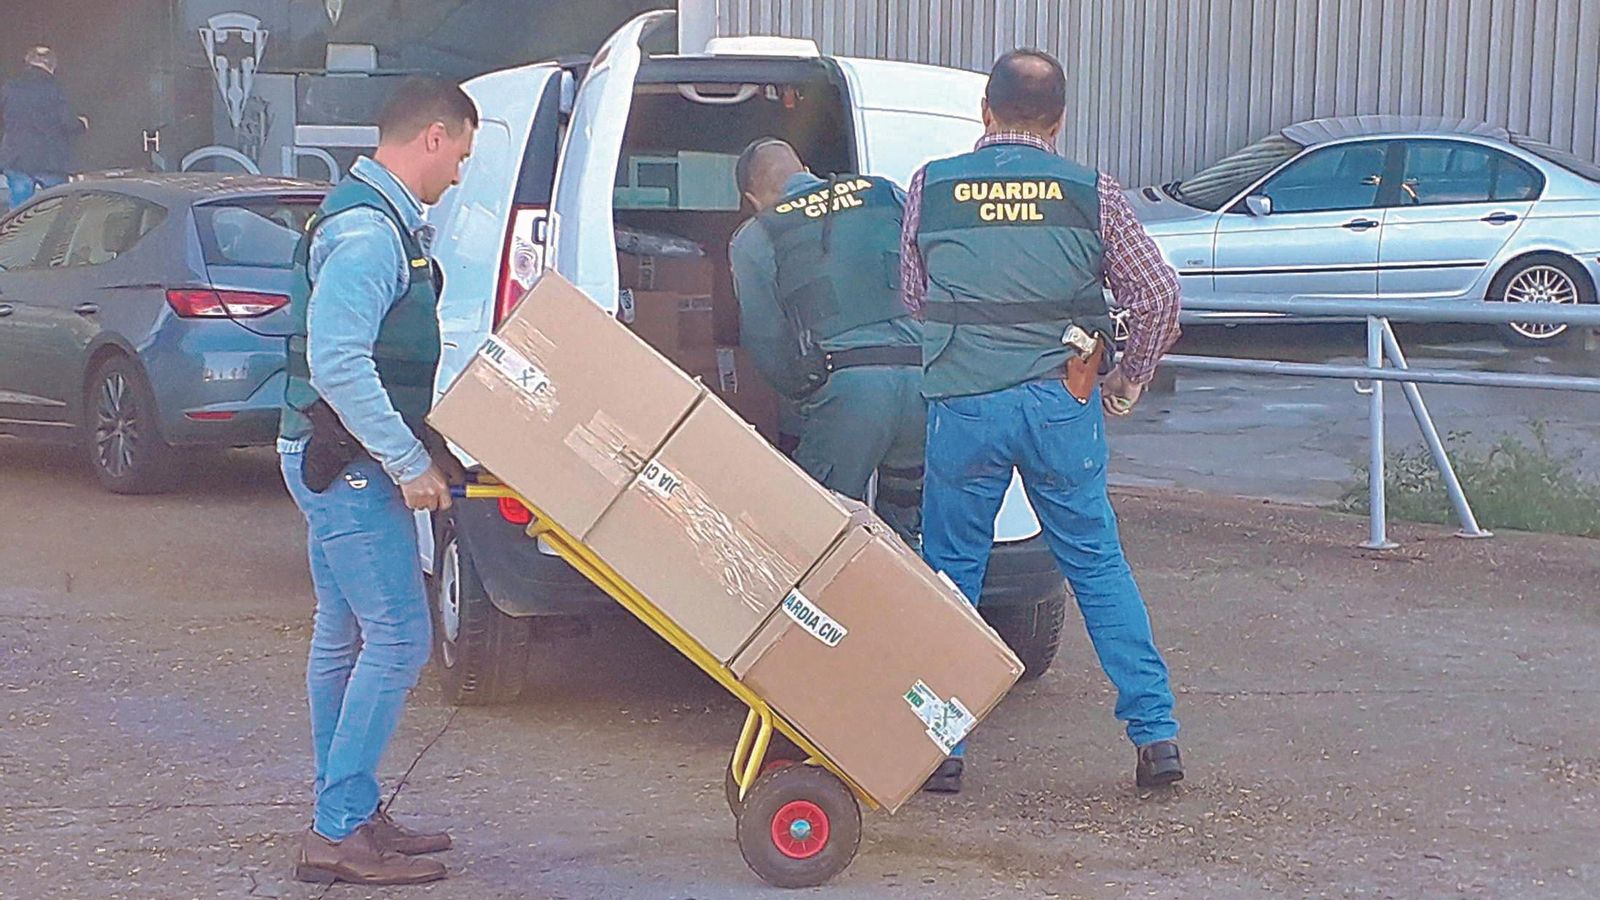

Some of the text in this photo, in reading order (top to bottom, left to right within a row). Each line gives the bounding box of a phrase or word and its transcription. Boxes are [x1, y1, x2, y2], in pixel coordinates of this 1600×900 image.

[775, 179, 873, 214] GUARDIA
[953, 181, 1064, 202] GUARDIA
[804, 194, 864, 218] CIVIL
[979, 202, 1045, 221] CIVIL
